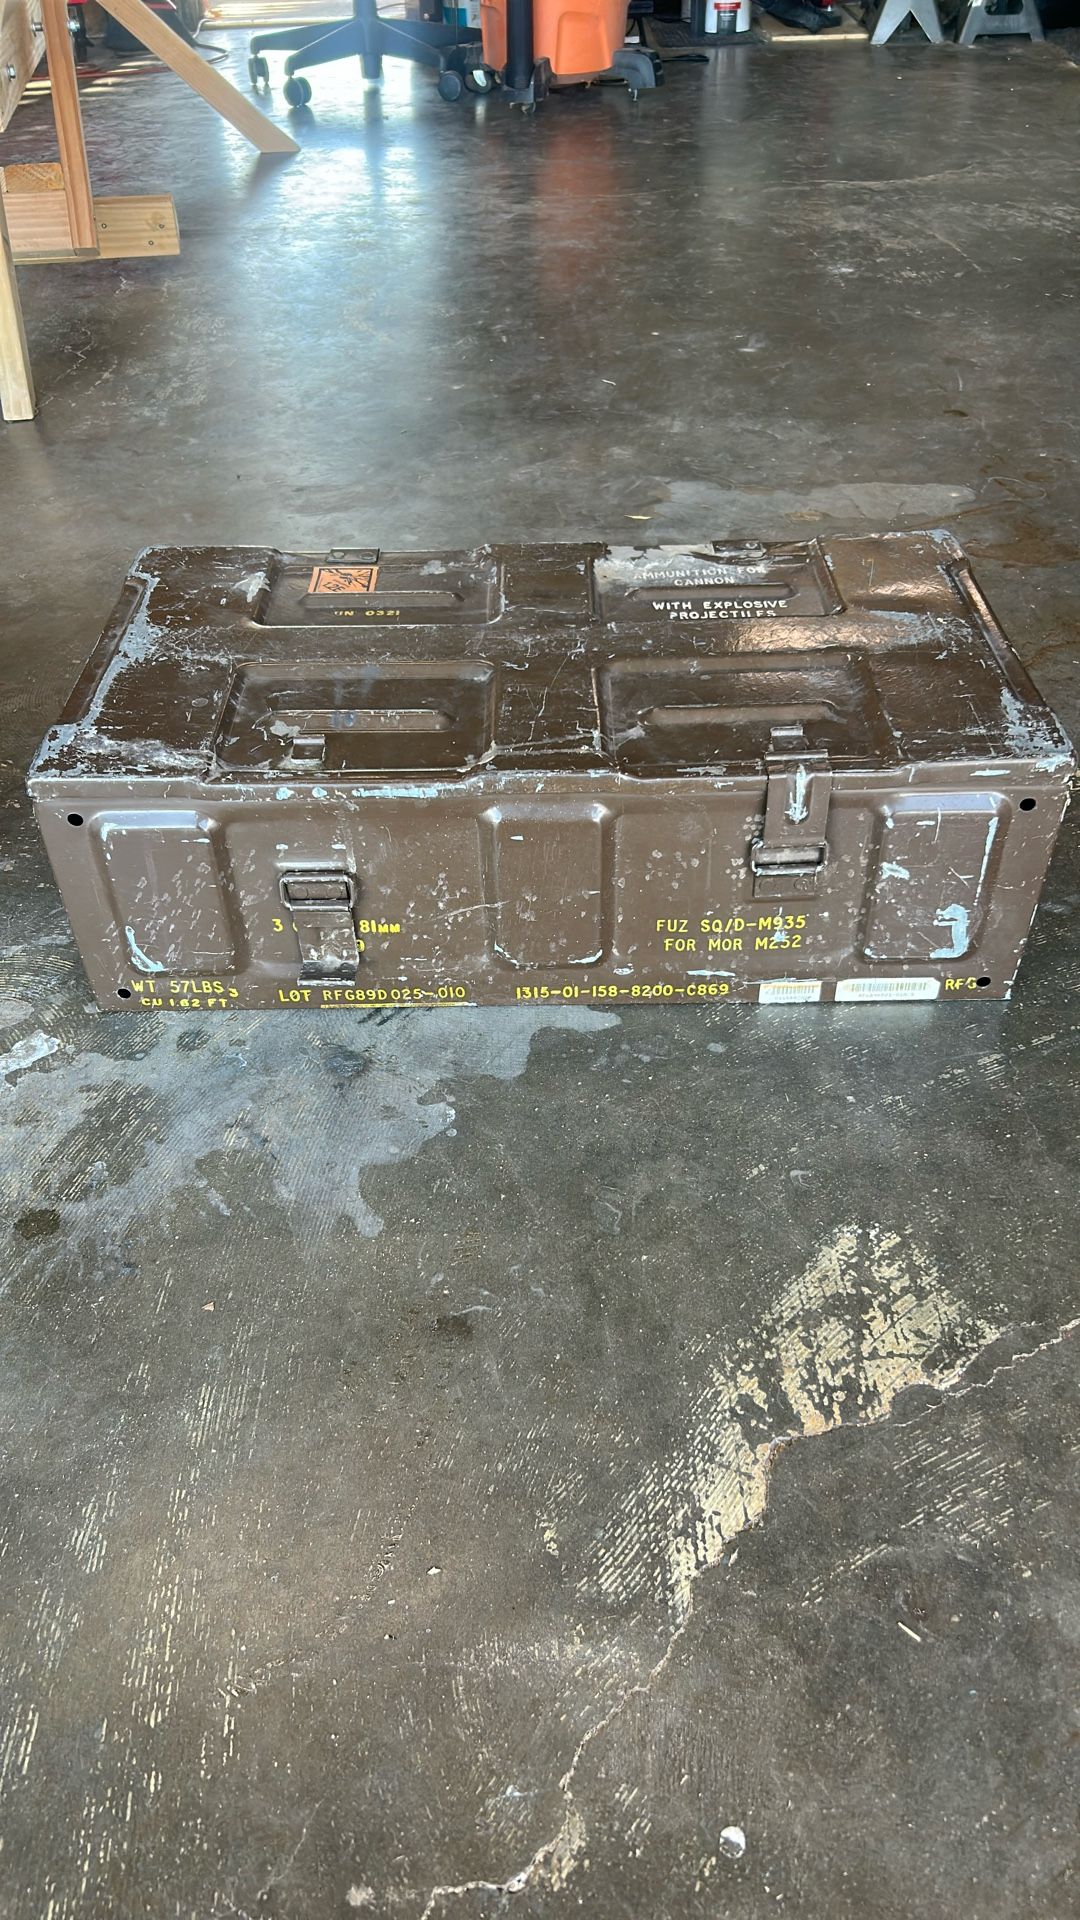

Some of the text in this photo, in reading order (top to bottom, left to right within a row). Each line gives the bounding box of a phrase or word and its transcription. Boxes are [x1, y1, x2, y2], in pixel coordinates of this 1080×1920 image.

[633, 565, 767, 580] AMMUNITION FOR
[674, 577, 735, 586] CANNON
[652, 600, 788, 610] WITH EXPLOSIVE
[669, 610, 777, 620] PROJECTILES
[271, 918, 284, 933] 3
[656, 915, 807, 933] FUZ SQ/D-M935
[664, 935, 802, 952] FOR MOR M252
[131, 979, 156, 993] WT
[170, 980, 225, 994] 57LBS
[515, 983, 730, 999] 1315-01-158-8200-C869
[944, 976, 978, 991] RFG
[141, 997, 163, 1007] CU
[207, 998, 228, 1009] FT
[278, 989, 312, 1002] LOT
